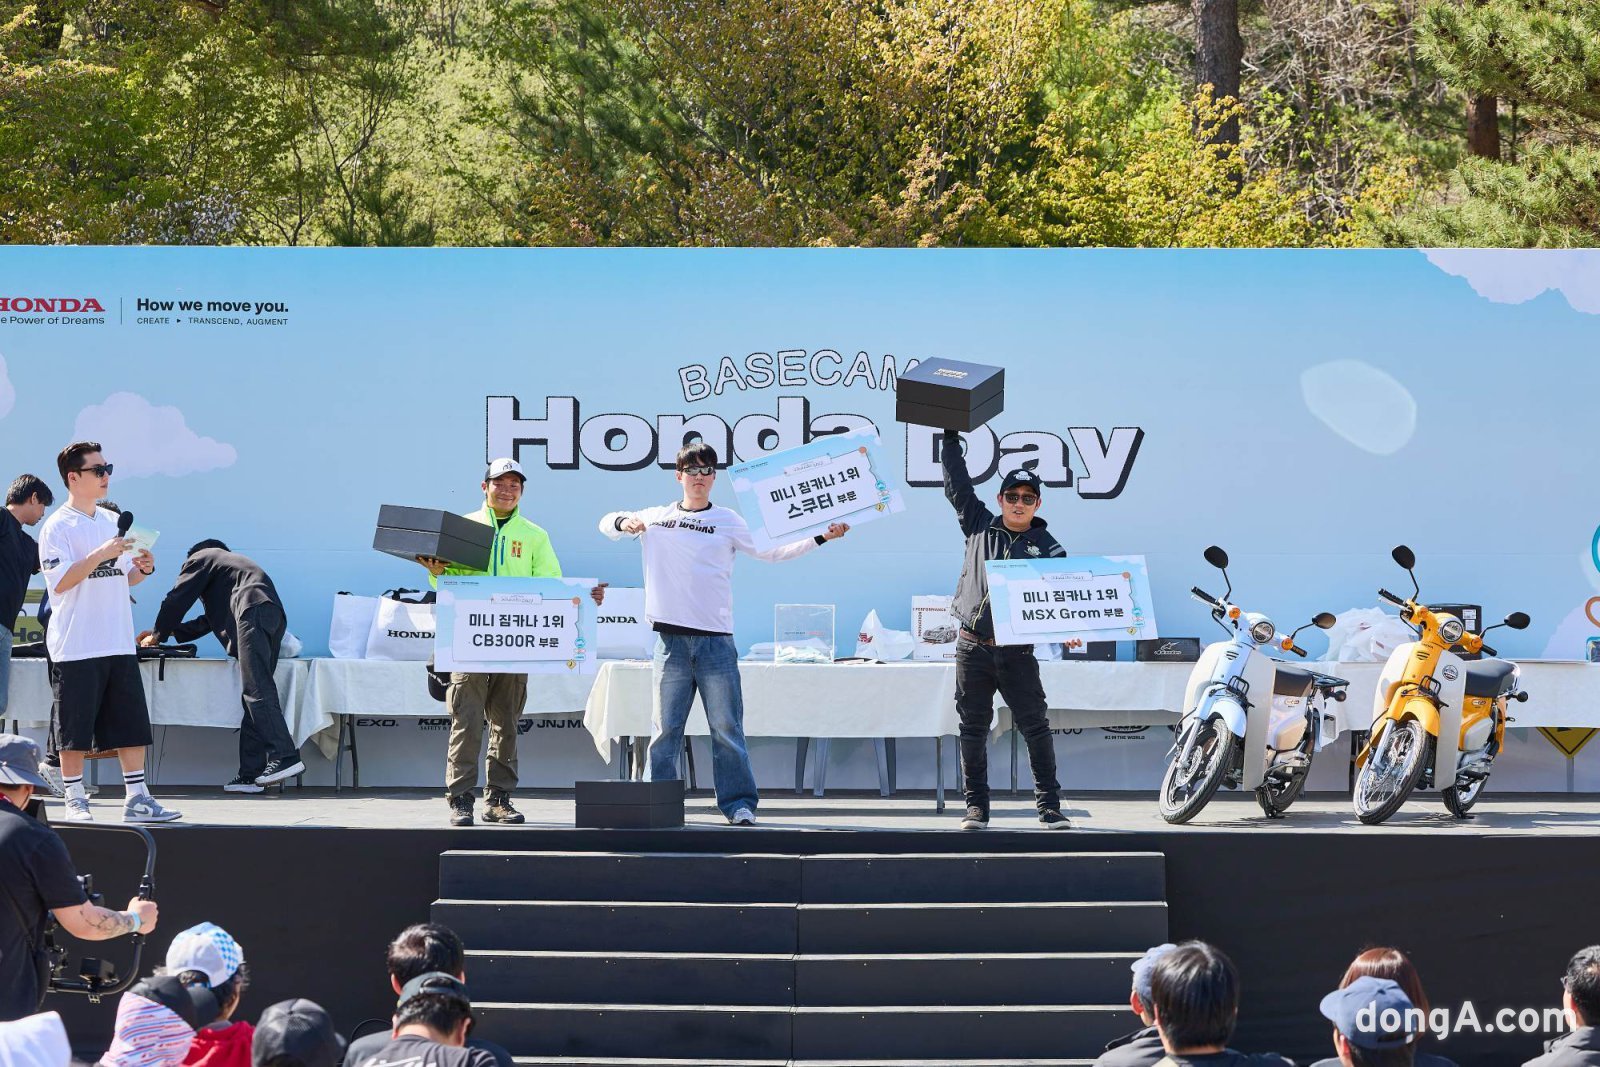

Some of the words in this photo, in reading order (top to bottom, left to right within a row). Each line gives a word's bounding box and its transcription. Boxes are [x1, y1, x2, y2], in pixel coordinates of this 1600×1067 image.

[137, 298, 174, 311] How
[178, 301, 203, 311] we
[207, 301, 252, 311] move
[255, 302, 289, 315] you.
[10, 316, 45, 324] Power
[48, 316, 59, 324] of
[62, 316, 105, 325] Dreams
[188, 317, 243, 326] TRANSCEND,
[678, 349, 920, 402] BASECAM
[906, 422, 1145, 499] Day
[770, 485, 796, 503] 미니
[797, 473, 836, 495] 짐카나
[837, 466, 860, 483] 1위
[787, 492, 834, 519] 스쿠터
[837, 490, 857, 504] 부문
[1023, 591, 1049, 603] 미니
[1052, 589, 1092, 602] 짐카나
[1096, 588, 1118, 601] 1위
[469, 613, 494, 627] 미니
[499, 614, 538, 628] 짐카나
[542, 615, 564, 628] 1위
[597, 616, 638, 624] ONDA
[1022, 608, 1056, 621] MSX
[1059, 608, 1101, 620] Grom
[1103, 607, 1124, 617] 부문
[472, 633, 535, 648] CB300R
[538, 637, 559, 648] 부문
[537, 719, 565, 729] JNJ
